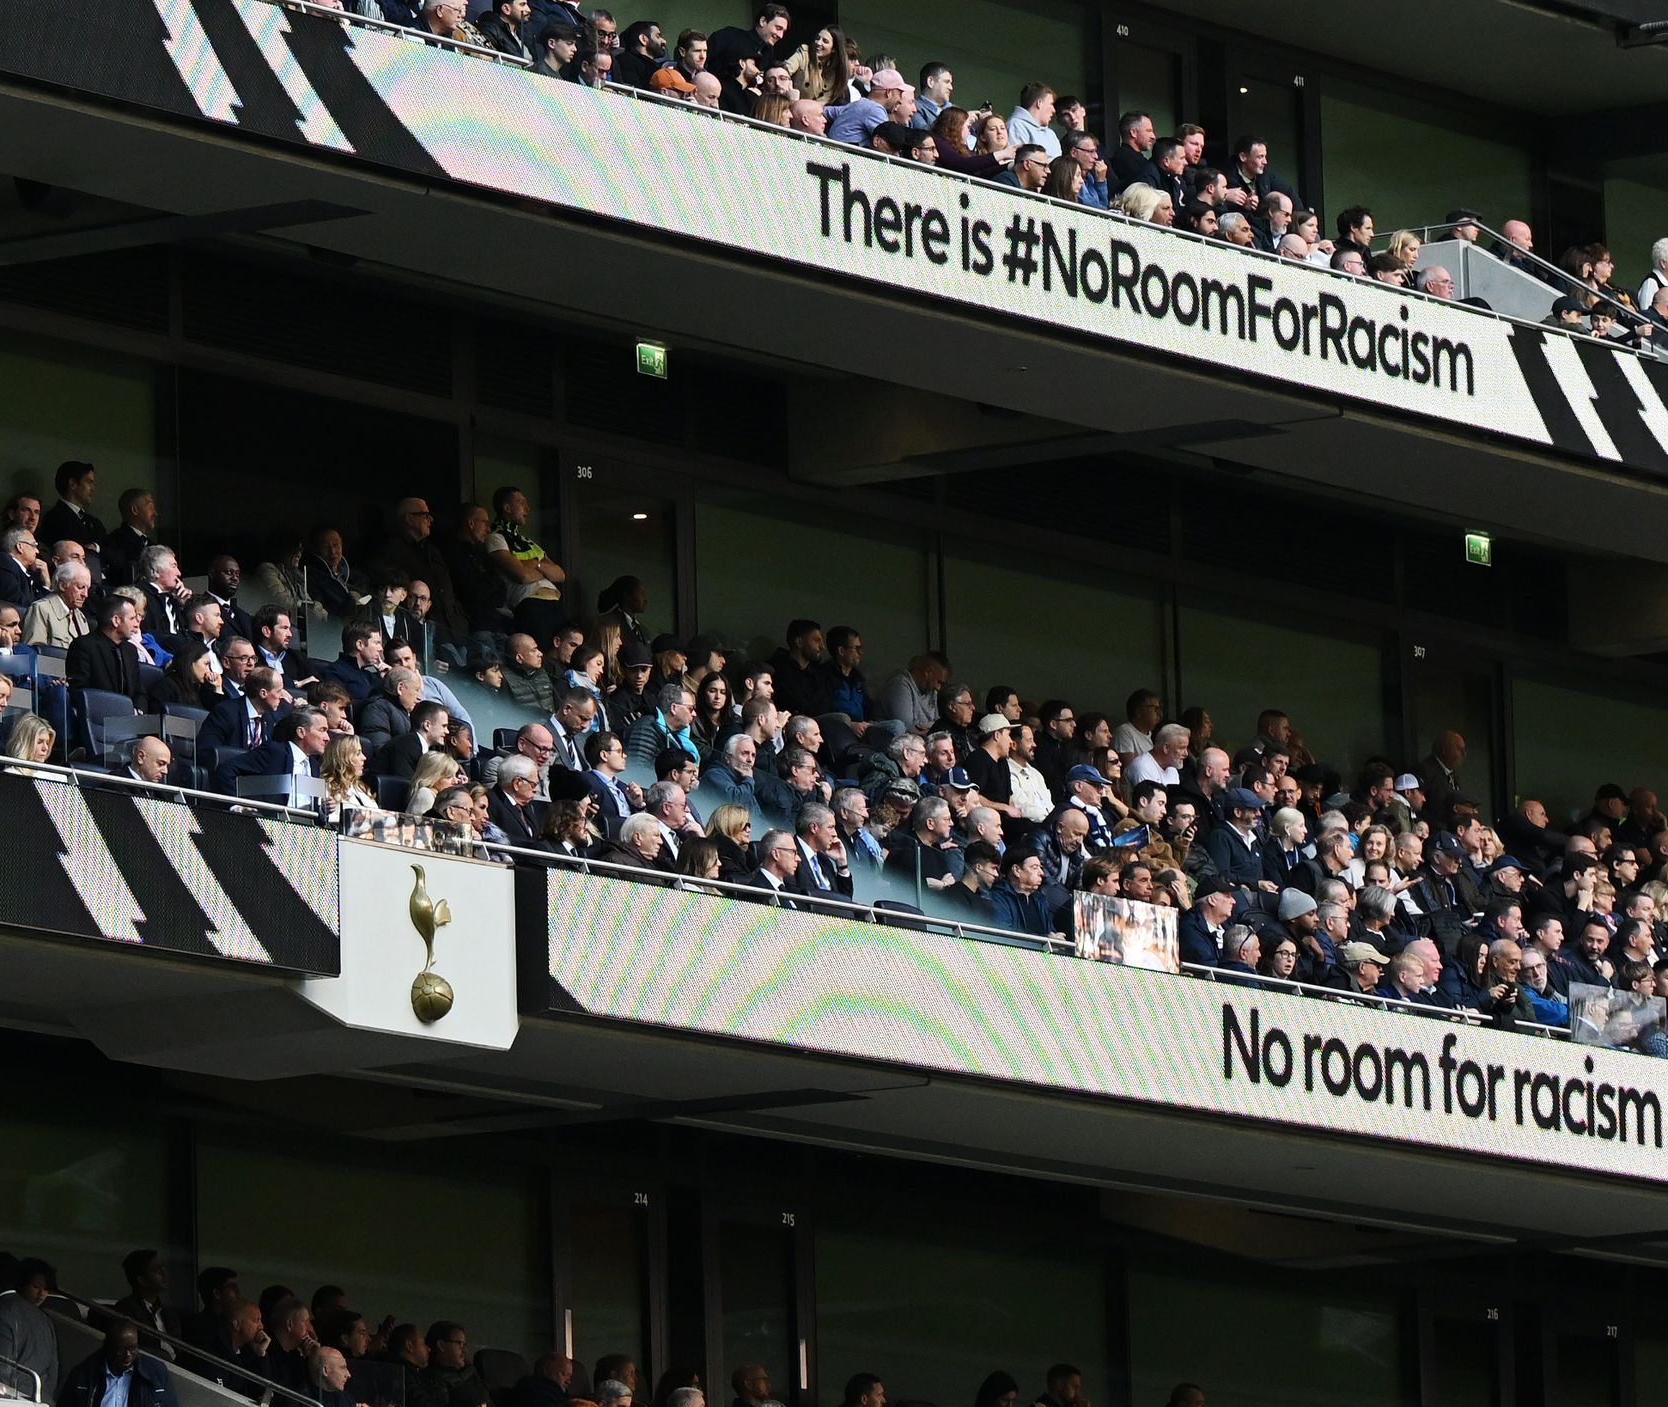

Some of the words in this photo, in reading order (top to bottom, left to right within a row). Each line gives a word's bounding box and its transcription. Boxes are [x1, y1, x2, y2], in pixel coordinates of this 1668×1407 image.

[1116, 24, 1129, 37] 410
[1294, 75, 1305, 87] 411
[806, 163, 948, 264] There
[959, 193, 992, 274] is
[1003, 212, 1475, 397] #NoRoomForRacism
[641, 355, 653, 366] Exit
[577, 465, 592, 479] 306
[1469, 544, 1480, 554] Exit
[1413, 645, 1425, 659] 307
[1223, 1004, 1293, 1088] No
[1304, 1032, 1430, 1109] room
[1439, 1032, 1506, 1121] for
[1515, 1056, 1663, 1149] racism
[634, 1192, 648, 1207] 214
[781, 1213, 795, 1227] 215
[1487, 1308, 1499, 1321] 216
[1606, 1326, 1618, 1339] 217
